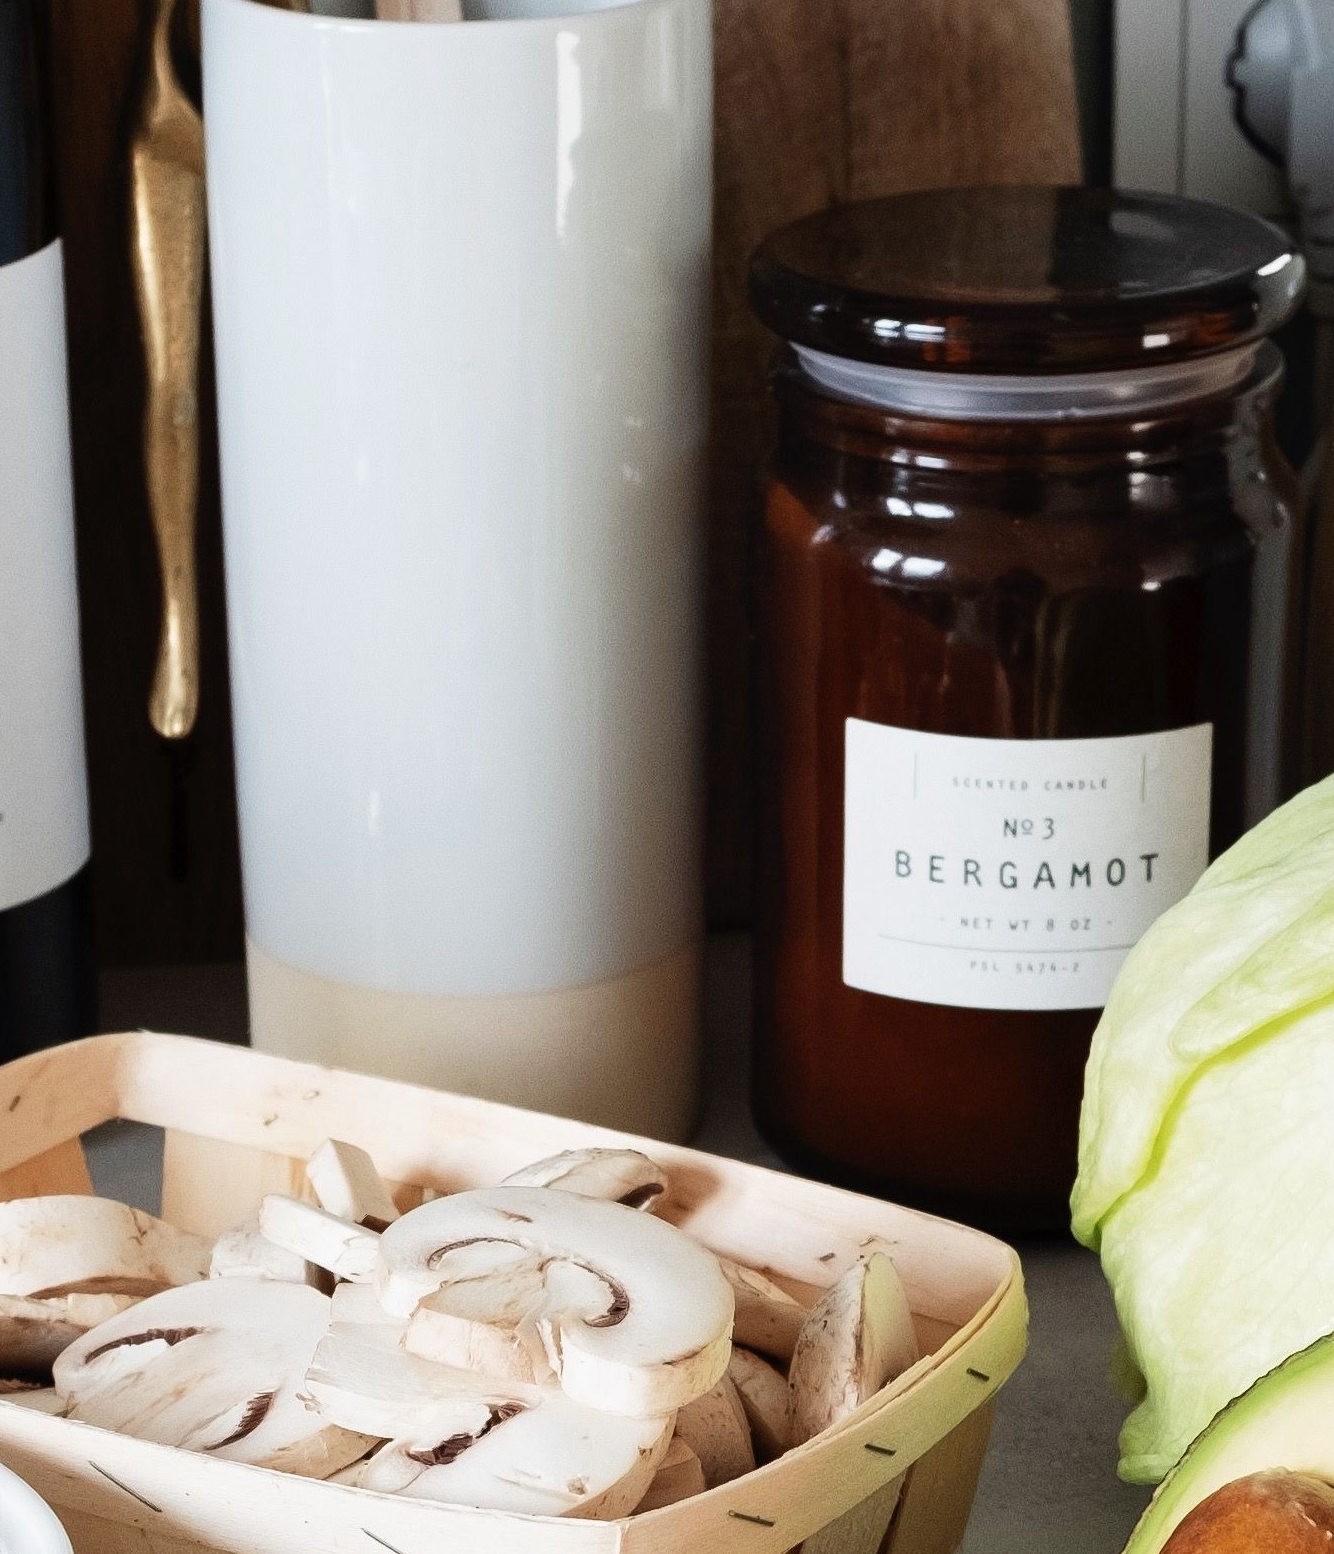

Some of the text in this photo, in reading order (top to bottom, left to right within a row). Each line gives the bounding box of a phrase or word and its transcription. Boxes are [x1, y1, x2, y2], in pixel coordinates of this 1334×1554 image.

[952, 776, 1108, 791] SCENTED CANDLE
[895, 849, 1160, 890] BERGAMOT
[960, 916, 993, 930] NET
[1008, 919, 1031, 931] WT
[1070, 917, 1092, 931] OZ
